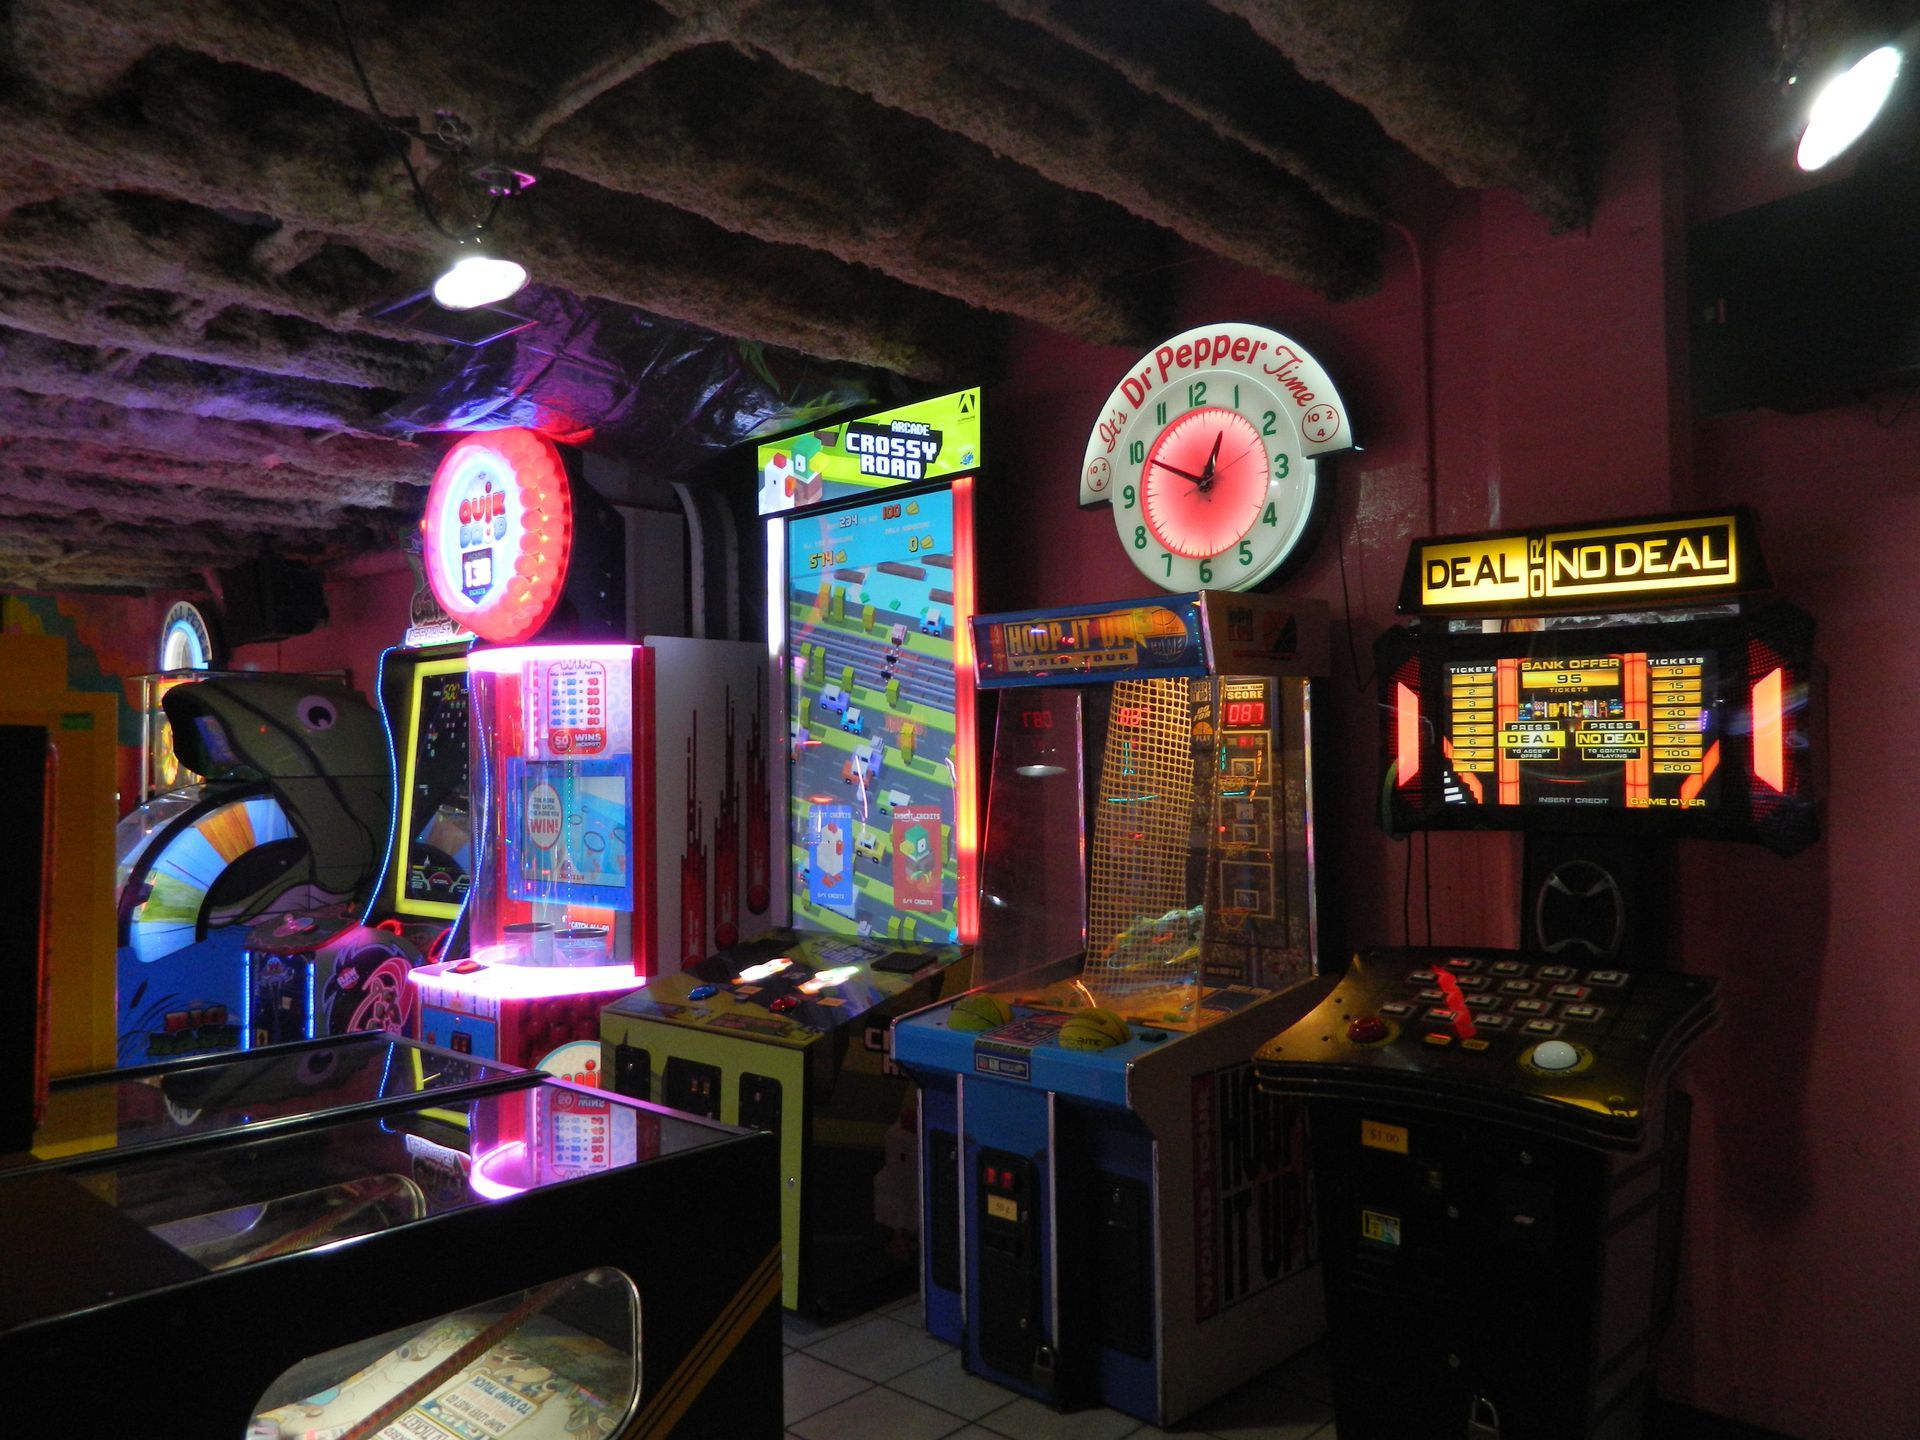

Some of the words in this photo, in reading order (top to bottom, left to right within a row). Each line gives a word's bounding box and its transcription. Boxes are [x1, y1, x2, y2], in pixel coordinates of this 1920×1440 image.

[1100, 409, 1127, 453] It's
[1120, 366, 1153, 410] Dr
[1155, 334, 1268, 383] Pepper
[1263, 345, 1316, 407] Time
[1188, 381, 1207, 408] 12
[1234, 384, 1240, 409] 1
[1156, 401, 1167, 426] 11
[1307, 412, 1319, 423] 10
[1326, 410, 1333, 419] 2
[891, 420, 931, 436] ARCADE
[1262, 410, 1277, 436] 2
[1317, 428, 1325, 437] 4
[846, 432, 938, 462] CROSSY
[1129, 440, 1145, 465] 10
[860, 454, 922, 480] ROAD
[1089, 466, 1098, 475] 10
[1101, 463, 1108, 472] 2
[1274, 453, 1289, 479] 3
[1122, 485, 1136, 509] 9
[882, 504, 901, 520] 100
[1261, 502, 1278, 527] 4
[908, 536, 919, 552] 0
[1134, 525, 1147, 549] 8
[1239, 540, 1253, 565] 5
[1161, 553, 1172, 577] 7
[1199, 558, 1213, 583] 6
[1426, 552, 1520, 590] DEAL
[1529, 538, 1545, 599] OR
[1553, 545, 1608, 581] NO
[1615, 535, 1728, 577] DEAL
[1008, 622, 1064, 655] HOOP
[1071, 619, 1091, 650] IT
[1013, 655, 1069, 668] WORLD
[1082, 652, 1130, 663] TOUR
[1522, 660, 1564, 671] BANK
[1569, 658, 1620, 669] OFFER
[1648, 657, 1705, 666] TICKETS
[1450, 666, 1497, 674] TICKETS
[1557, 673, 1582, 684] 95
[1226, 690, 1264, 700] SCORE
[1197, 704, 1210, 714] GO
[1468, 700, 1476, 708] 3
[1193, 710, 1211, 722] FOR
[1229, 703, 1265, 722] 087
[1590, 722, 1633, 730] PRESS
[1668, 723, 1687, 731] 50
[575, 733, 602, 742] WINS
[1507, 734, 1555, 744] DEAL
[1579, 734, 1601, 744] NO
[1603, 733, 1644, 744] DEAL
[1630, 797, 1667, 806] GAME
[1669, 797, 1706, 807] OVER
[530, 818, 559, 834] WIN!
[1370, 1127, 1400, 1145] $1.00
[471, 1375, 497, 1395] TRUCK
[494, 1390, 521, 1407] DUMP
[516, 1402, 533, 1415] TO
